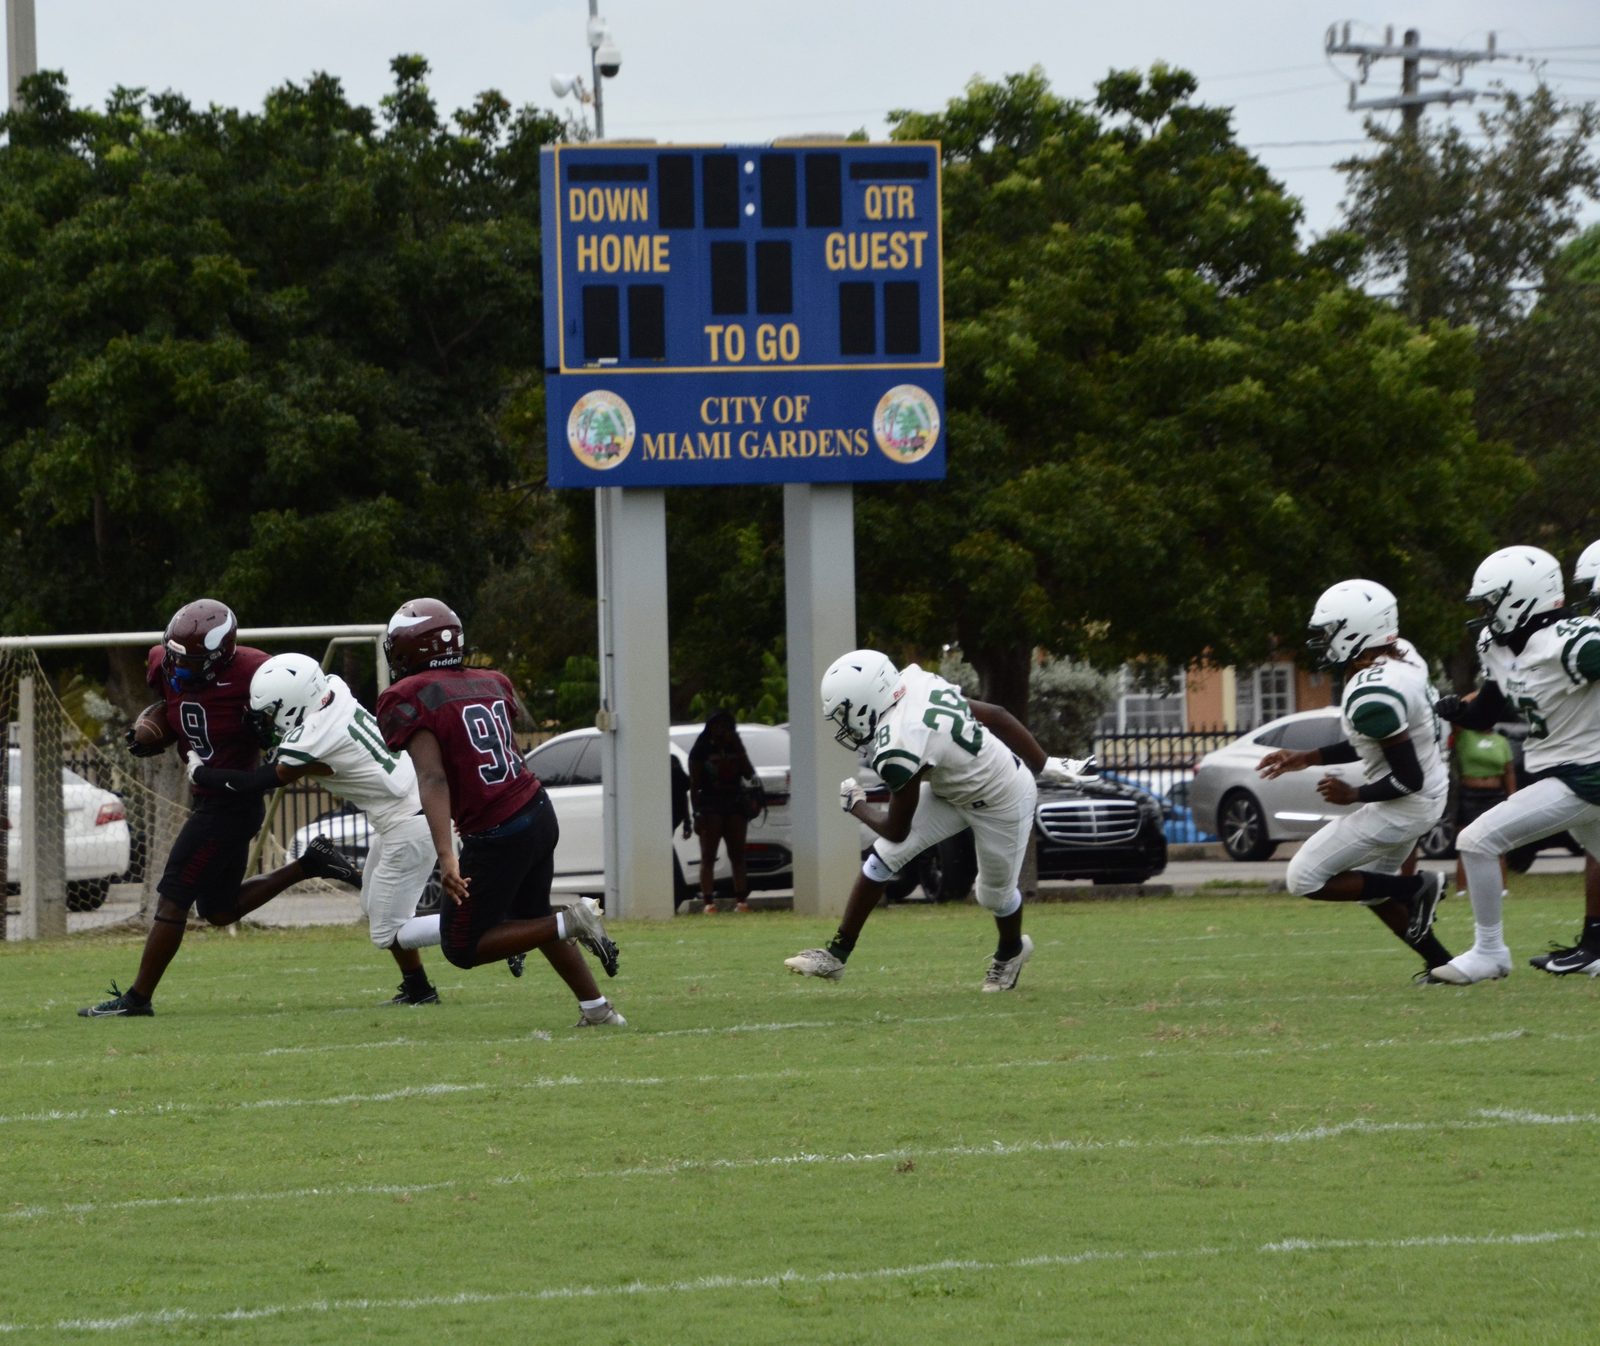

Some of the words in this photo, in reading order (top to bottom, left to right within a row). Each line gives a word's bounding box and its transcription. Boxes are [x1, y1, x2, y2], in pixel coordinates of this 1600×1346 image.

[569, 188, 648, 221] DOWN
[865, 186, 914, 219] QTR
[577, 235, 670, 272] HOME
[825, 232, 928, 270] GUEST
[705, 325, 745, 362] TO
[756, 323, 800, 362] GO
[700, 396, 766, 424] CITY
[772, 395, 810, 423] OF
[642, 432, 732, 460] MIAMI
[739, 429, 869, 458] GARDENS
[1355, 667, 1385, 686] 12
[179, 701, 214, 760] 9
[347, 707, 400, 775] 10
[922, 688, 983, 757] 28
[462, 700, 522, 785] 91
